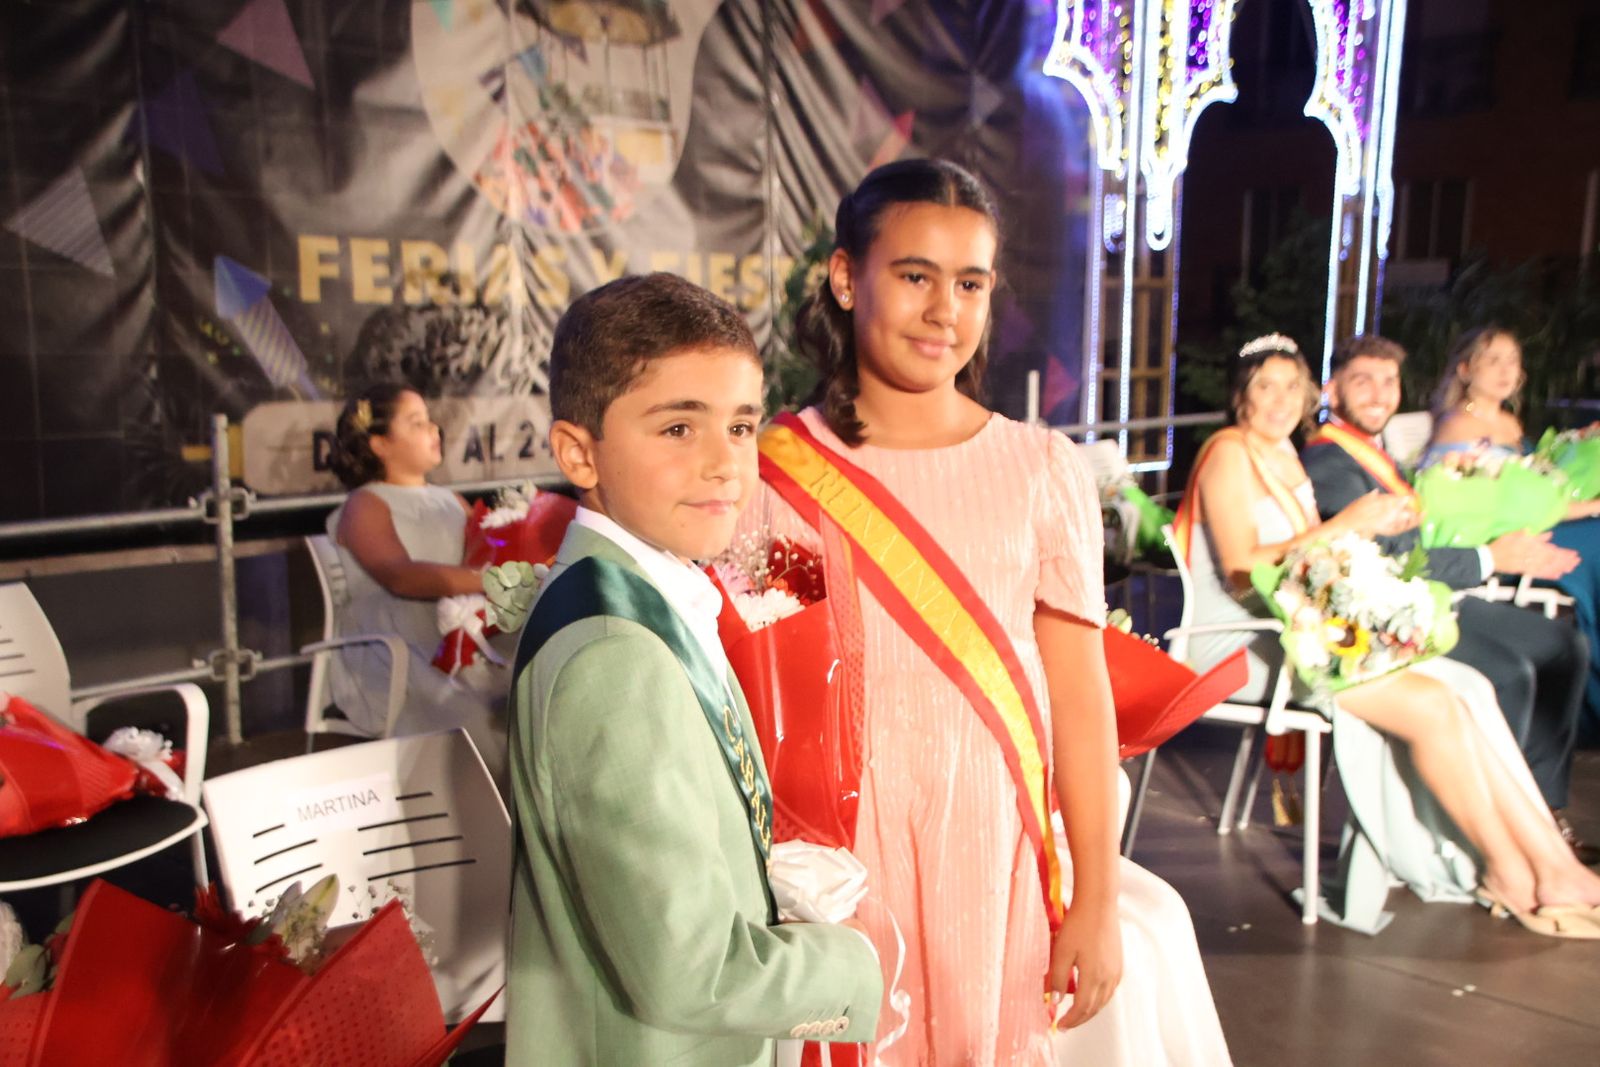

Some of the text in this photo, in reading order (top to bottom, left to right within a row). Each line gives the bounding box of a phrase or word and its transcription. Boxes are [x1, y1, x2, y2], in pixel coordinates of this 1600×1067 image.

[298, 234, 570, 309] FERIAS
[462, 423, 504, 463] AL
[518, 420, 554, 459] 2
[297, 789, 381, 822] MARTINA
[724, 704, 772, 850] CABALL
